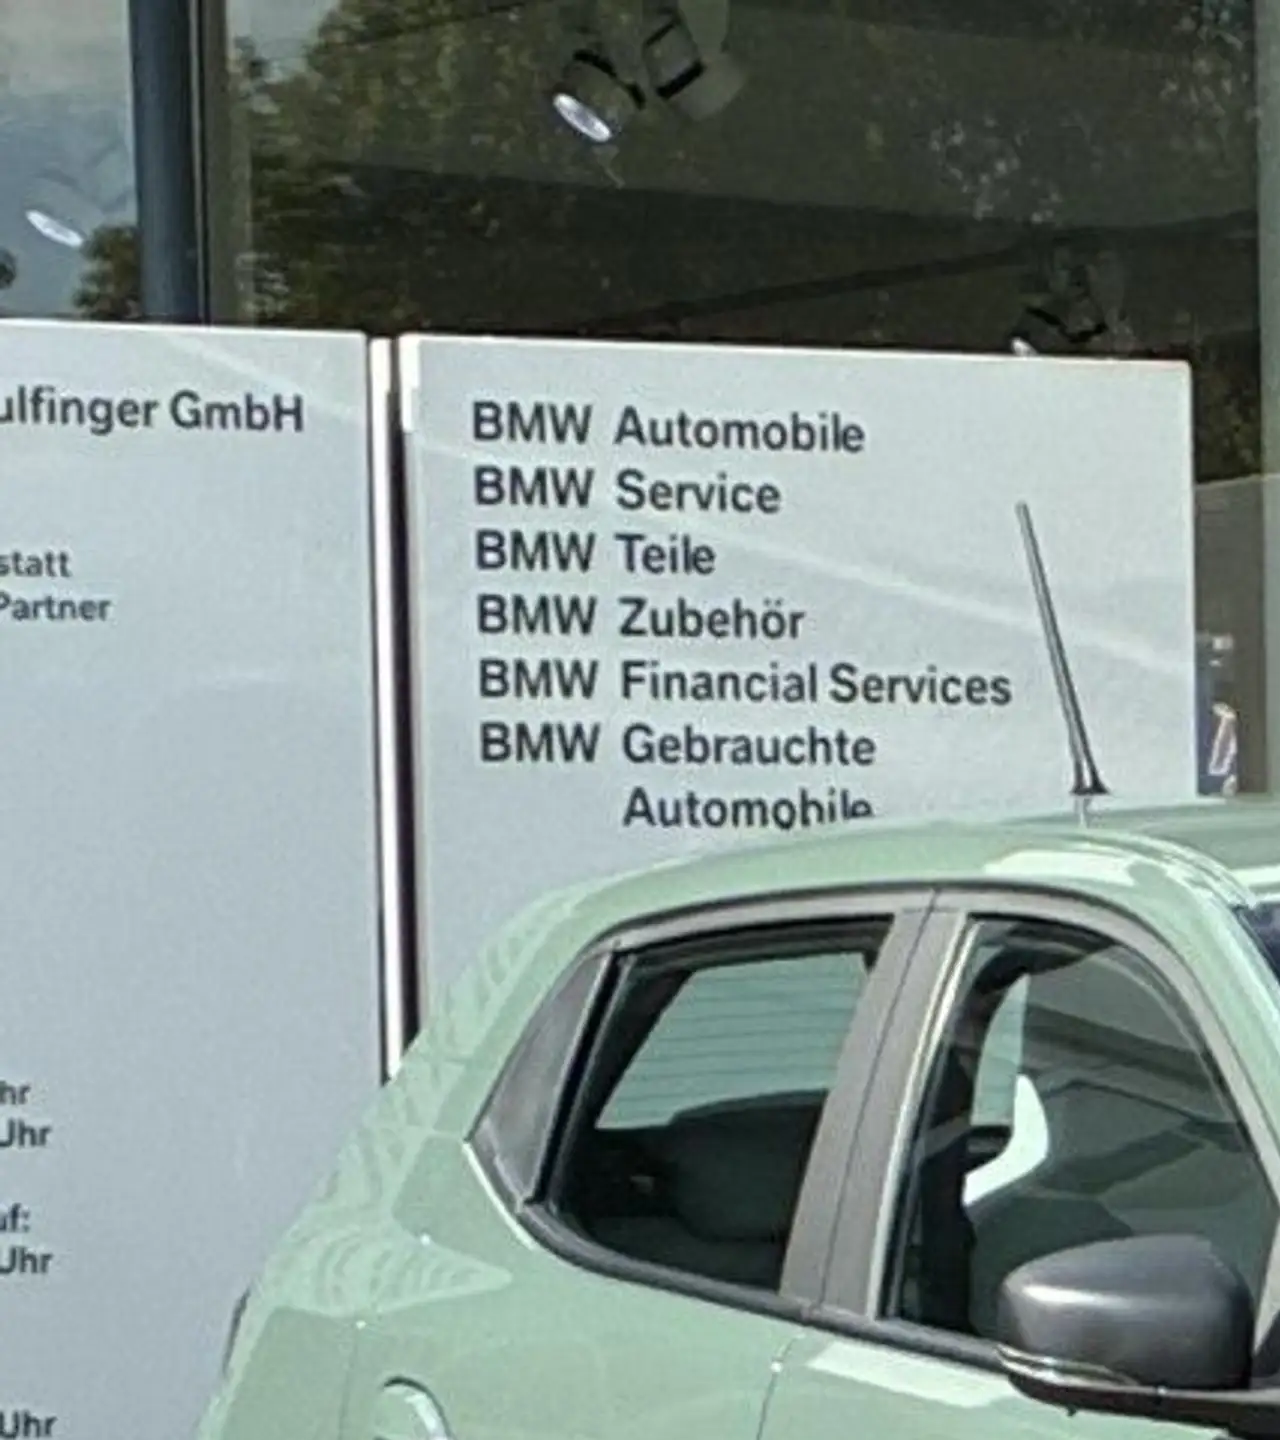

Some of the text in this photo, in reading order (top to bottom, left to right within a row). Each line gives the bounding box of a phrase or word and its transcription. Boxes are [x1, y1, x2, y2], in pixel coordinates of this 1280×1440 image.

[169, 389, 304, 433] GmbH
[473, 400, 865, 454] BMW Automobile
[474, 465, 781, 515] BMW Service
[476, 529, 716, 576] BMW Teile
[477, 593, 805, 640] BMW Zubehör
[479, 658, 1012, 706] BMW Financial Services
[480, 721, 876, 767] BMW Gebrauchte
[0, 1118, 52, 1149] Uhr
[0, 1246, 53, 1275] Uhr
[0, 1410, 57, 1440] Uhr
